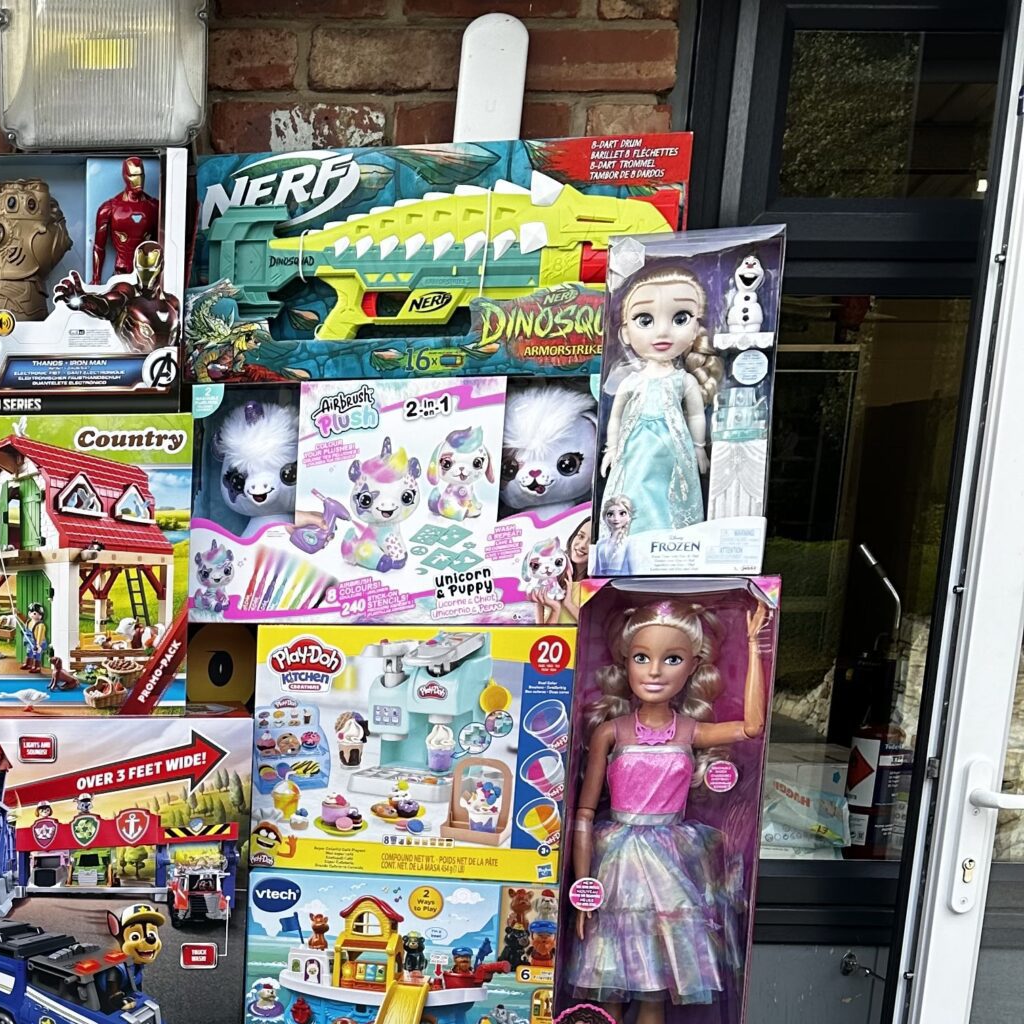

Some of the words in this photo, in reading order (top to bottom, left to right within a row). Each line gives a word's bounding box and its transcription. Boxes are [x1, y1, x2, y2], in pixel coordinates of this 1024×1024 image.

[620, 139, 642, 148] DRUM
[591, 150, 624, 160] BARILLET
[633, 147, 679, 158] FLÉCHETTES
[620, 160, 656, 169] TROMMEL
[590, 171, 619, 180] TAMBOR
[637, 169, 665, 178] DARDOS
[202, 152, 355, 228] NERF
[408, 292, 453, 313] NERF
[3, 398, 42, 410] SERIES
[77, 429, 184, 451] Country
[650, 541, 701, 554] FROZEN
[435, 568, 491, 587] Unicorn
[437, 589, 446, 599] &
[448, 580, 493, 597] Puppy
[342, 600, 366, 615] 240
[272, 645, 340, 670] Play-Doh
[537, 641, 564, 664] 20
[138, 640, 181, 703] PROMO-PACK
[77, 773, 112, 791] OVER
[115, 769, 124, 784] 3
[128, 763, 162, 782] FEET
[165, 755, 207, 775] WIDE!
[381, 853, 414, 862] COMPOUND
[255, 887, 298, 901] vtech
[423, 889, 430, 898] 2
[521, 969, 530, 980] 6
